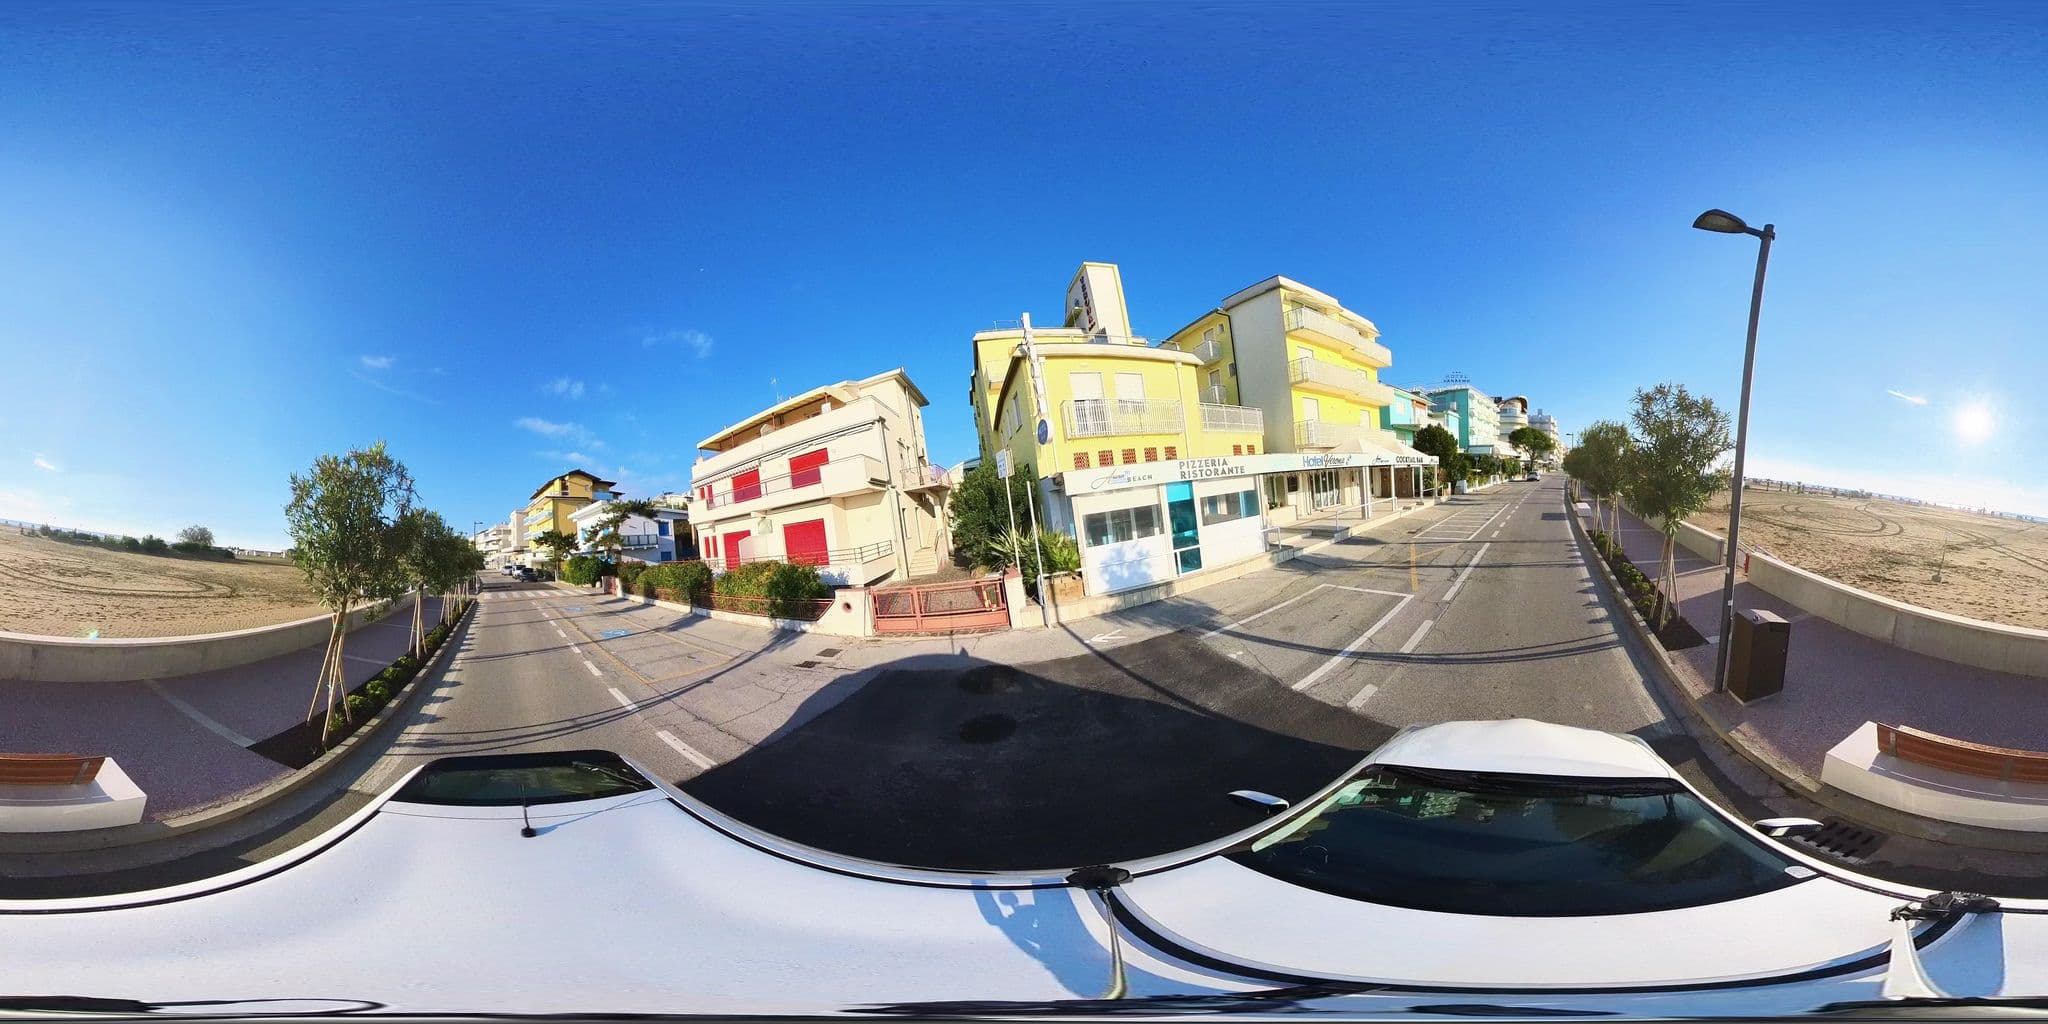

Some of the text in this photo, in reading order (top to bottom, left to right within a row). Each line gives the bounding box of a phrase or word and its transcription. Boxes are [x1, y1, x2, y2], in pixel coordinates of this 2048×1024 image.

[1178, 458, 1229, 470] PIZZERIA
[1302, 456, 1323, 467] Hotel
[1126, 474, 1153, 483] BEACH
[1180, 466, 1246, 480] RISTORANTE
